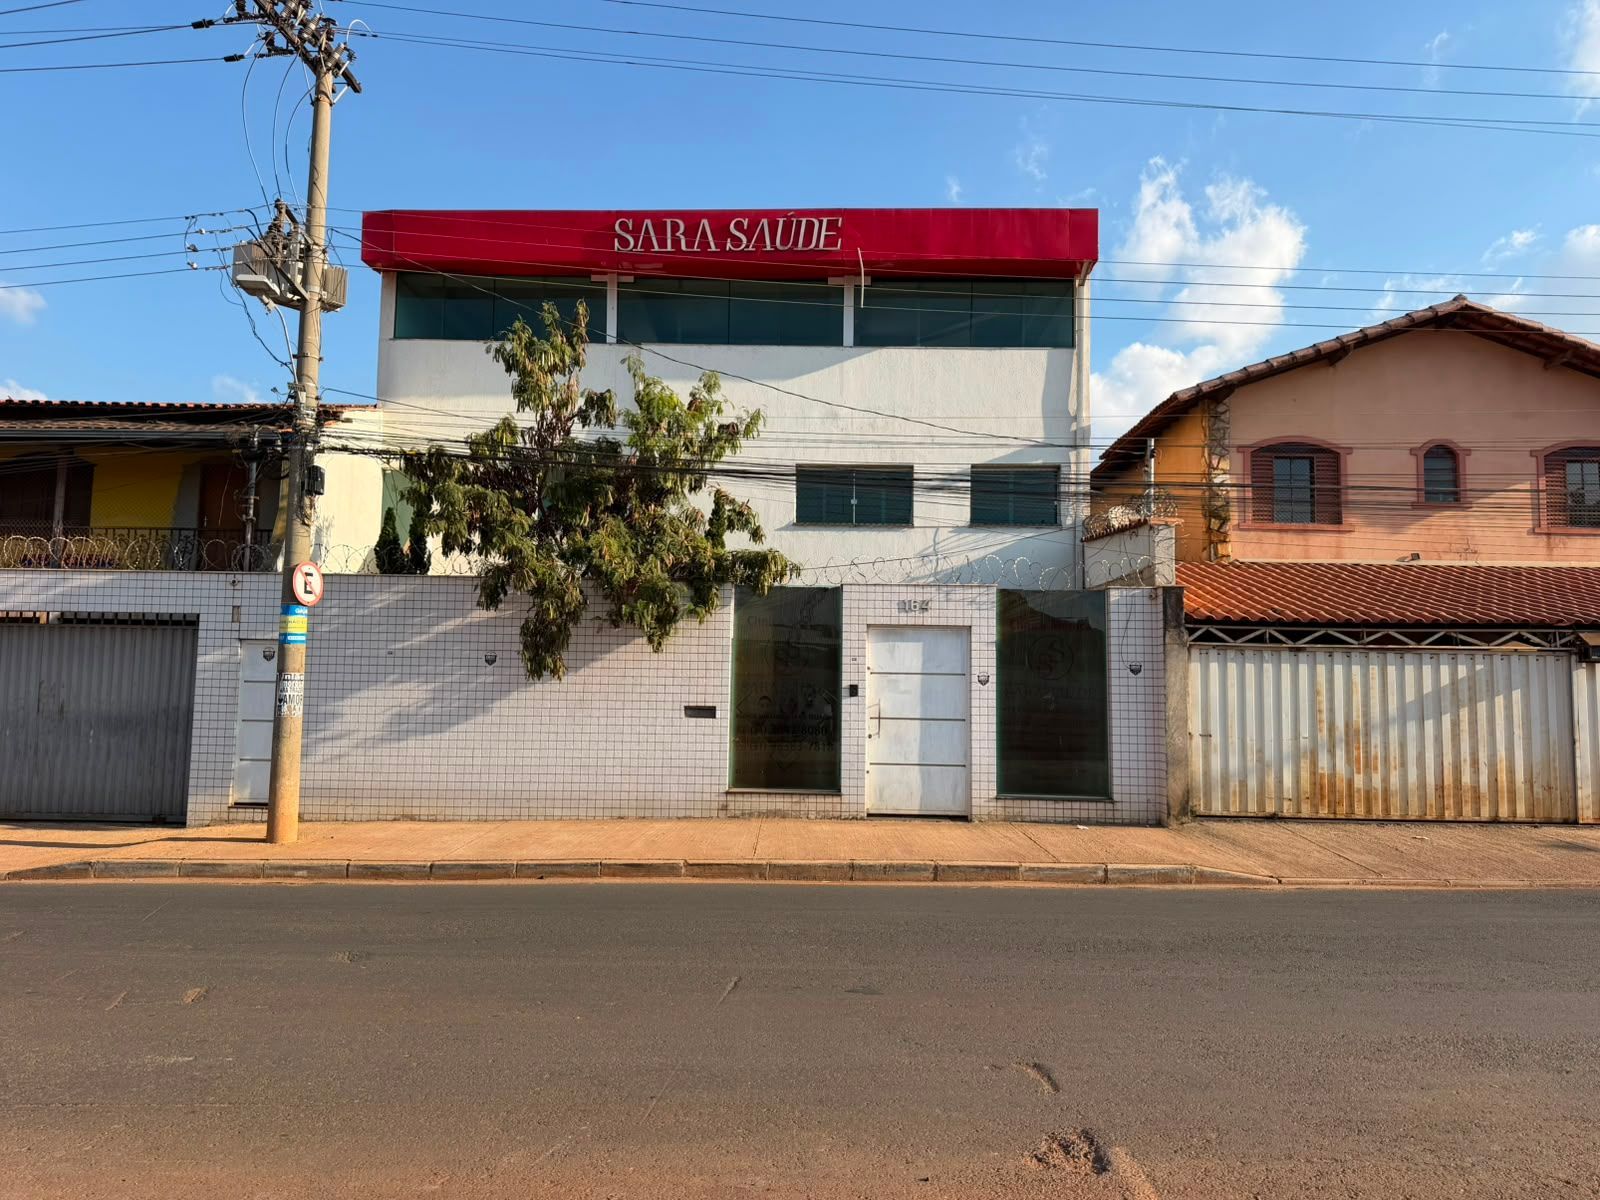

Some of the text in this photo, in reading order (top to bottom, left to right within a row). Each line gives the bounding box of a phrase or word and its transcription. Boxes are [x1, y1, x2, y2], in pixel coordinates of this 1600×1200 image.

[614, 211, 842, 252] SARA SAÚDE
[304, 572, 314, 595] E
[902, 599, 931, 612] 164
